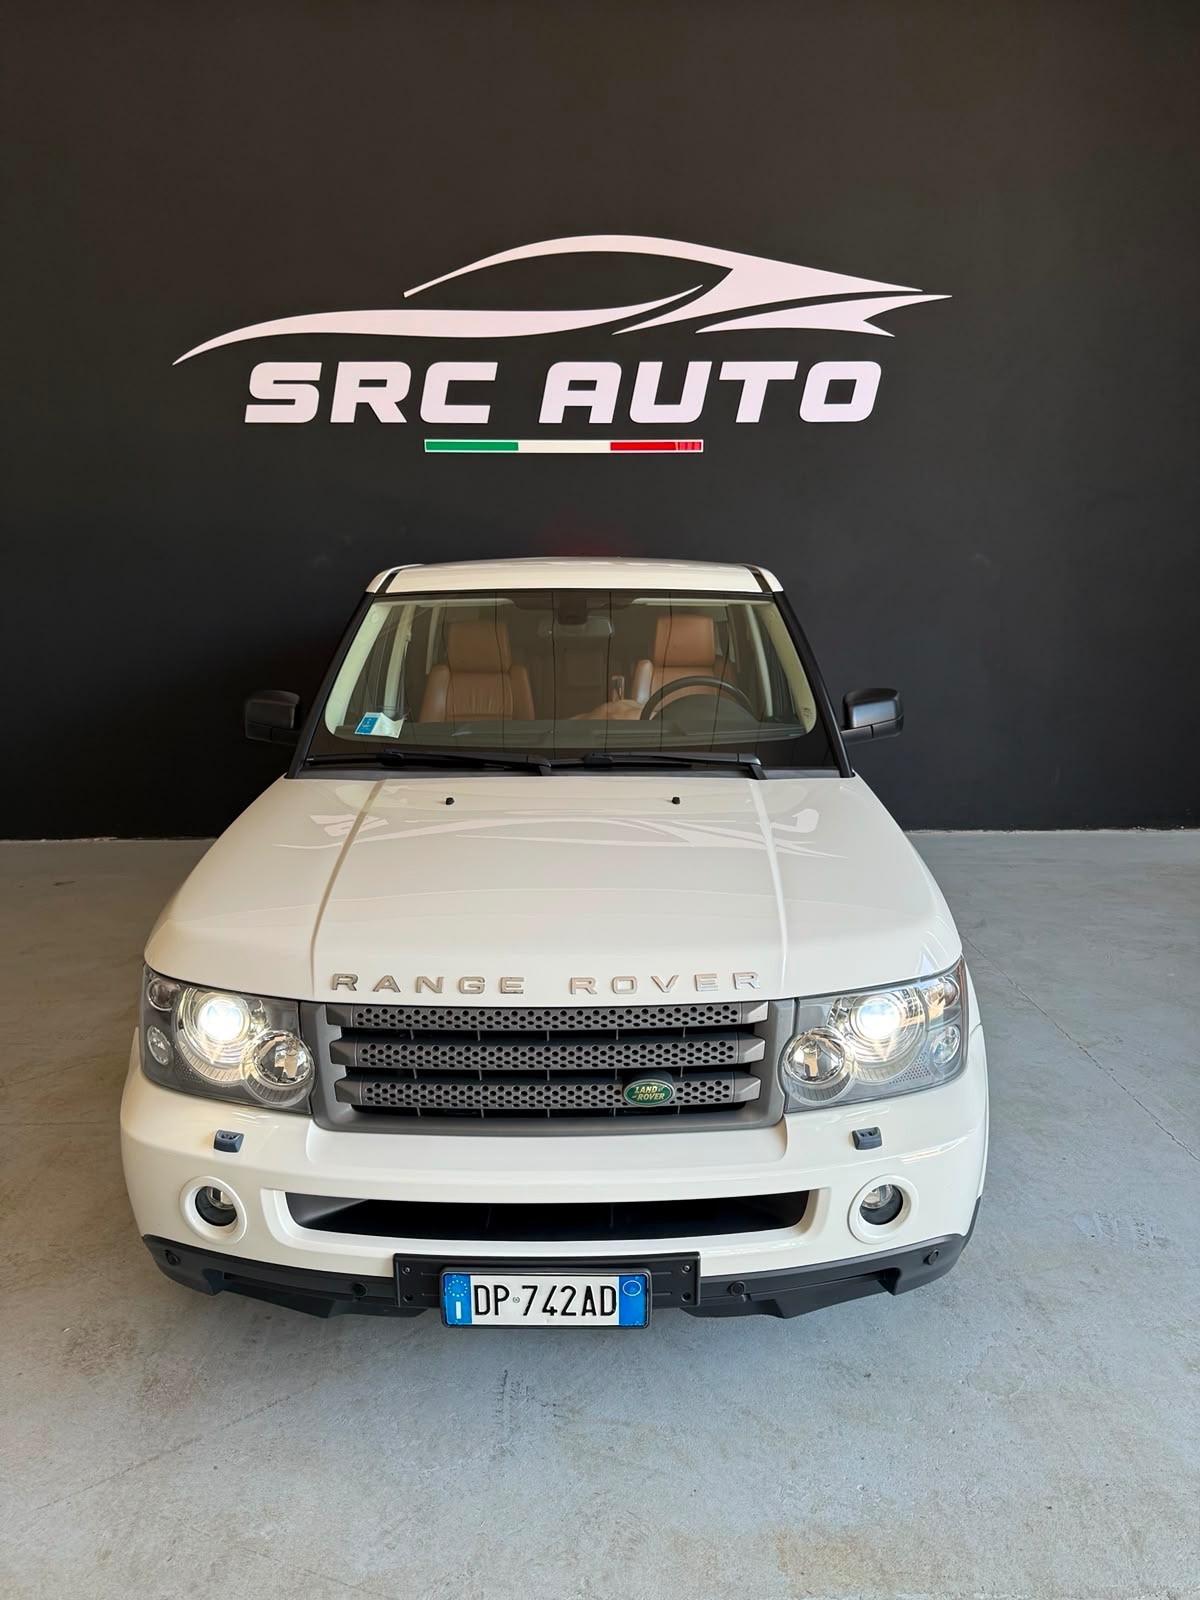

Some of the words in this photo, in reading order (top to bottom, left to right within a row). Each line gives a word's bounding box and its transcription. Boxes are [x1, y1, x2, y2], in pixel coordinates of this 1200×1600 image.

[244, 361, 498, 424] SRC
[538, 360, 882, 424] AUTO
[330, 973, 525, 994] RANGE
[570, 971, 761, 995] ROVER
[635, 1085, 658, 1094] LAND
[637, 1092, 665, 1101] ROVER
[473, 1284, 510, 1316] DP
[521, 1285, 617, 1316] 742AD
